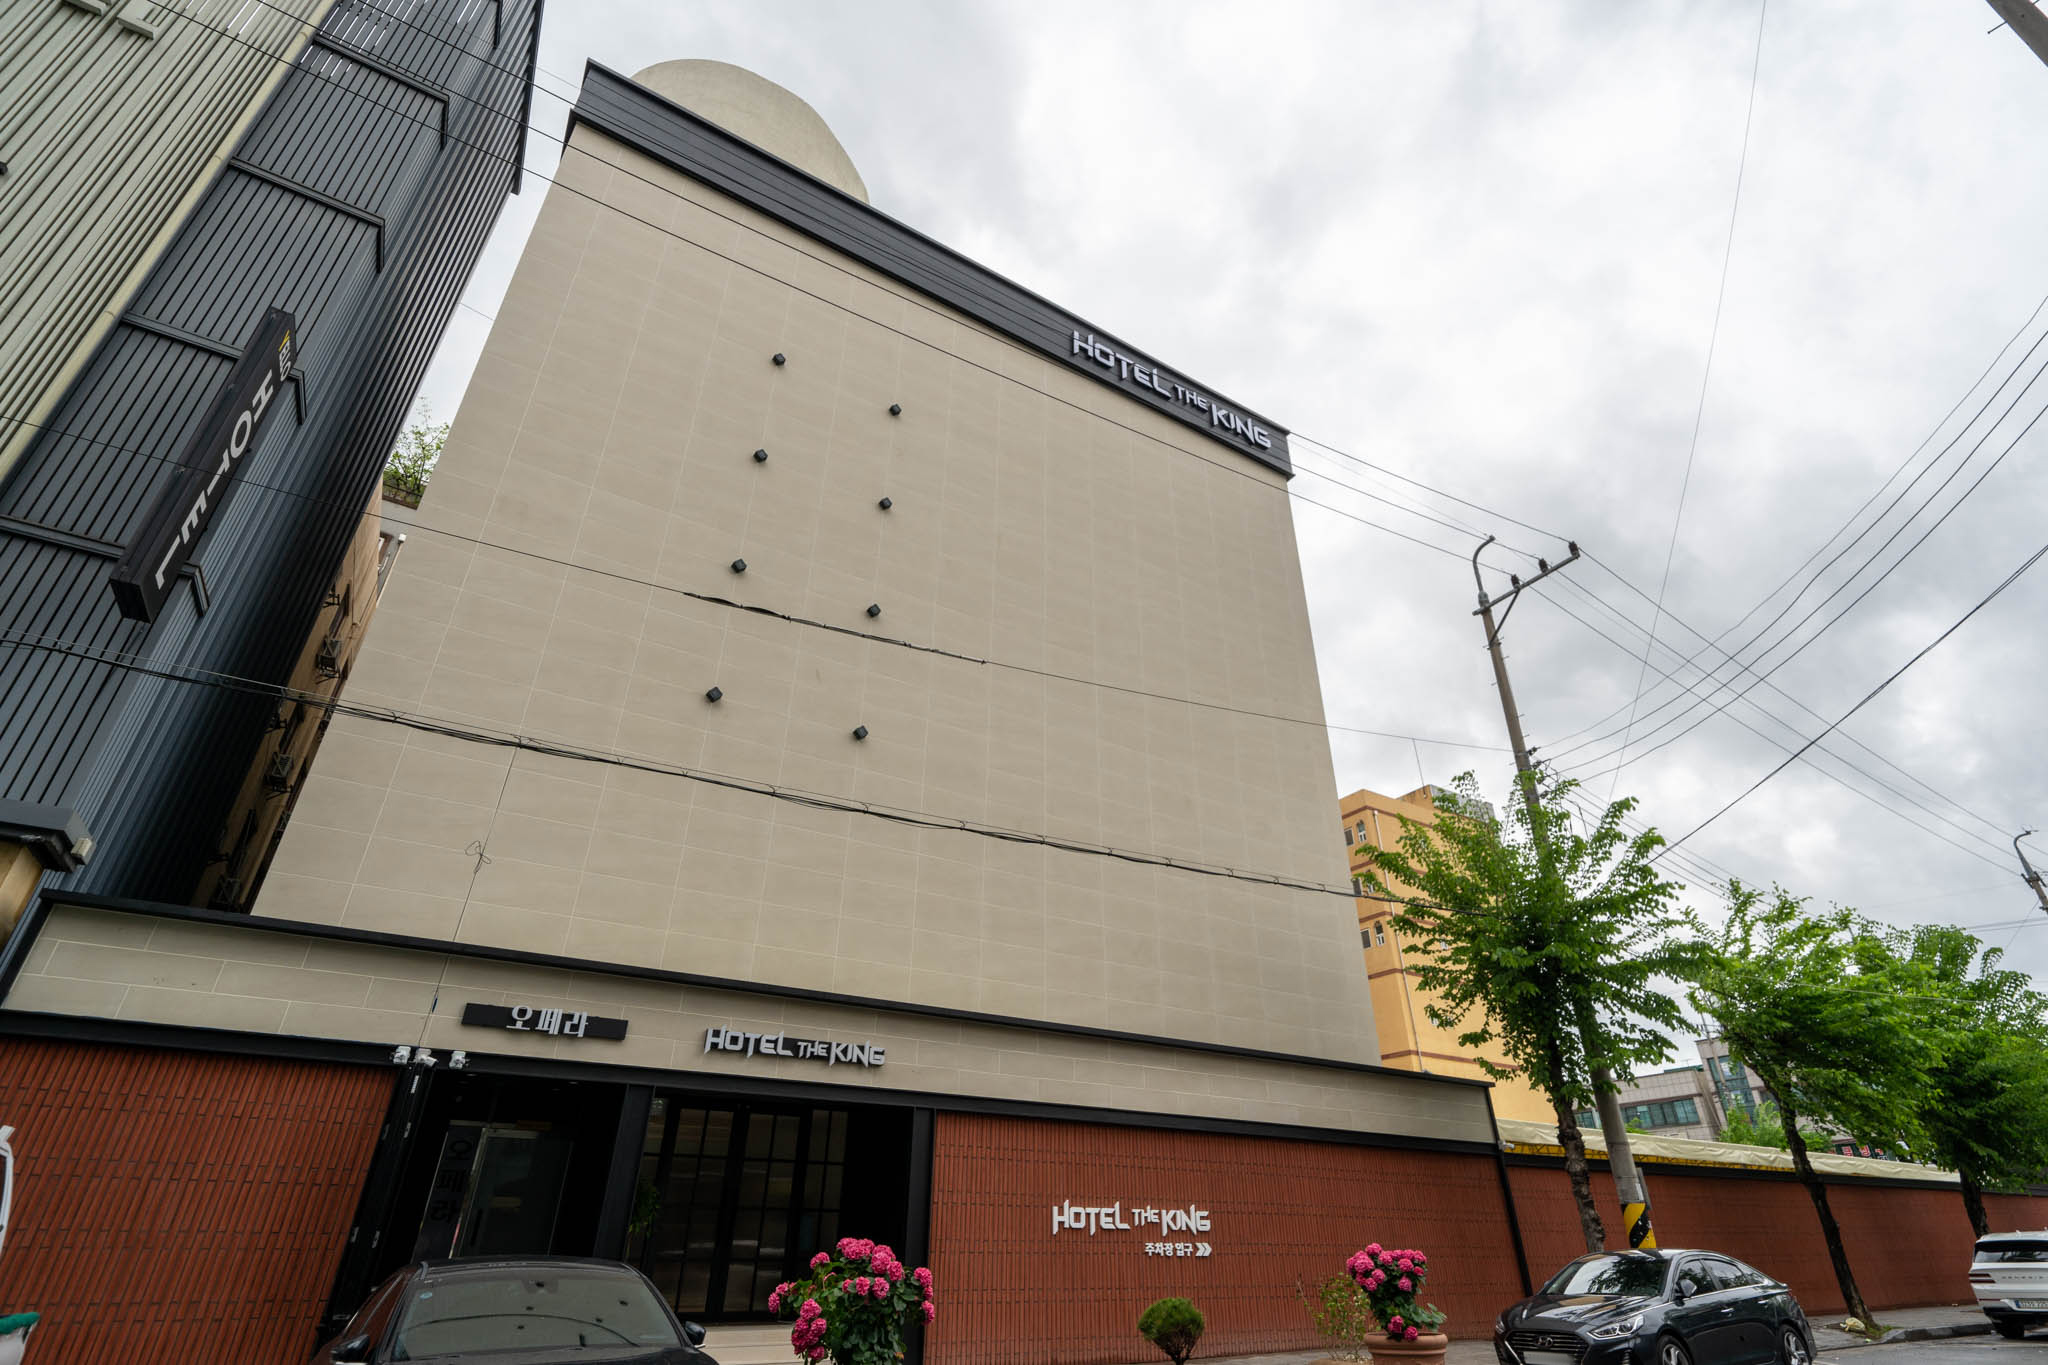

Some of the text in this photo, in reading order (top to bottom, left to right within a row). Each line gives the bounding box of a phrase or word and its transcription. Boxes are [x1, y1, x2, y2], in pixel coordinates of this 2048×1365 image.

[1072, 330, 1272, 449] HOTEL THE KING
[155, 369, 274, 590] HOTEL
[506, 1005, 589, 1038] 오페라
[704, 1024, 886, 1067] HOTEL THE KING
[1052, 1199, 1212, 1237] HOTEL THE KING
[1145, 1242, 1194, 1257] 주차장 입구
